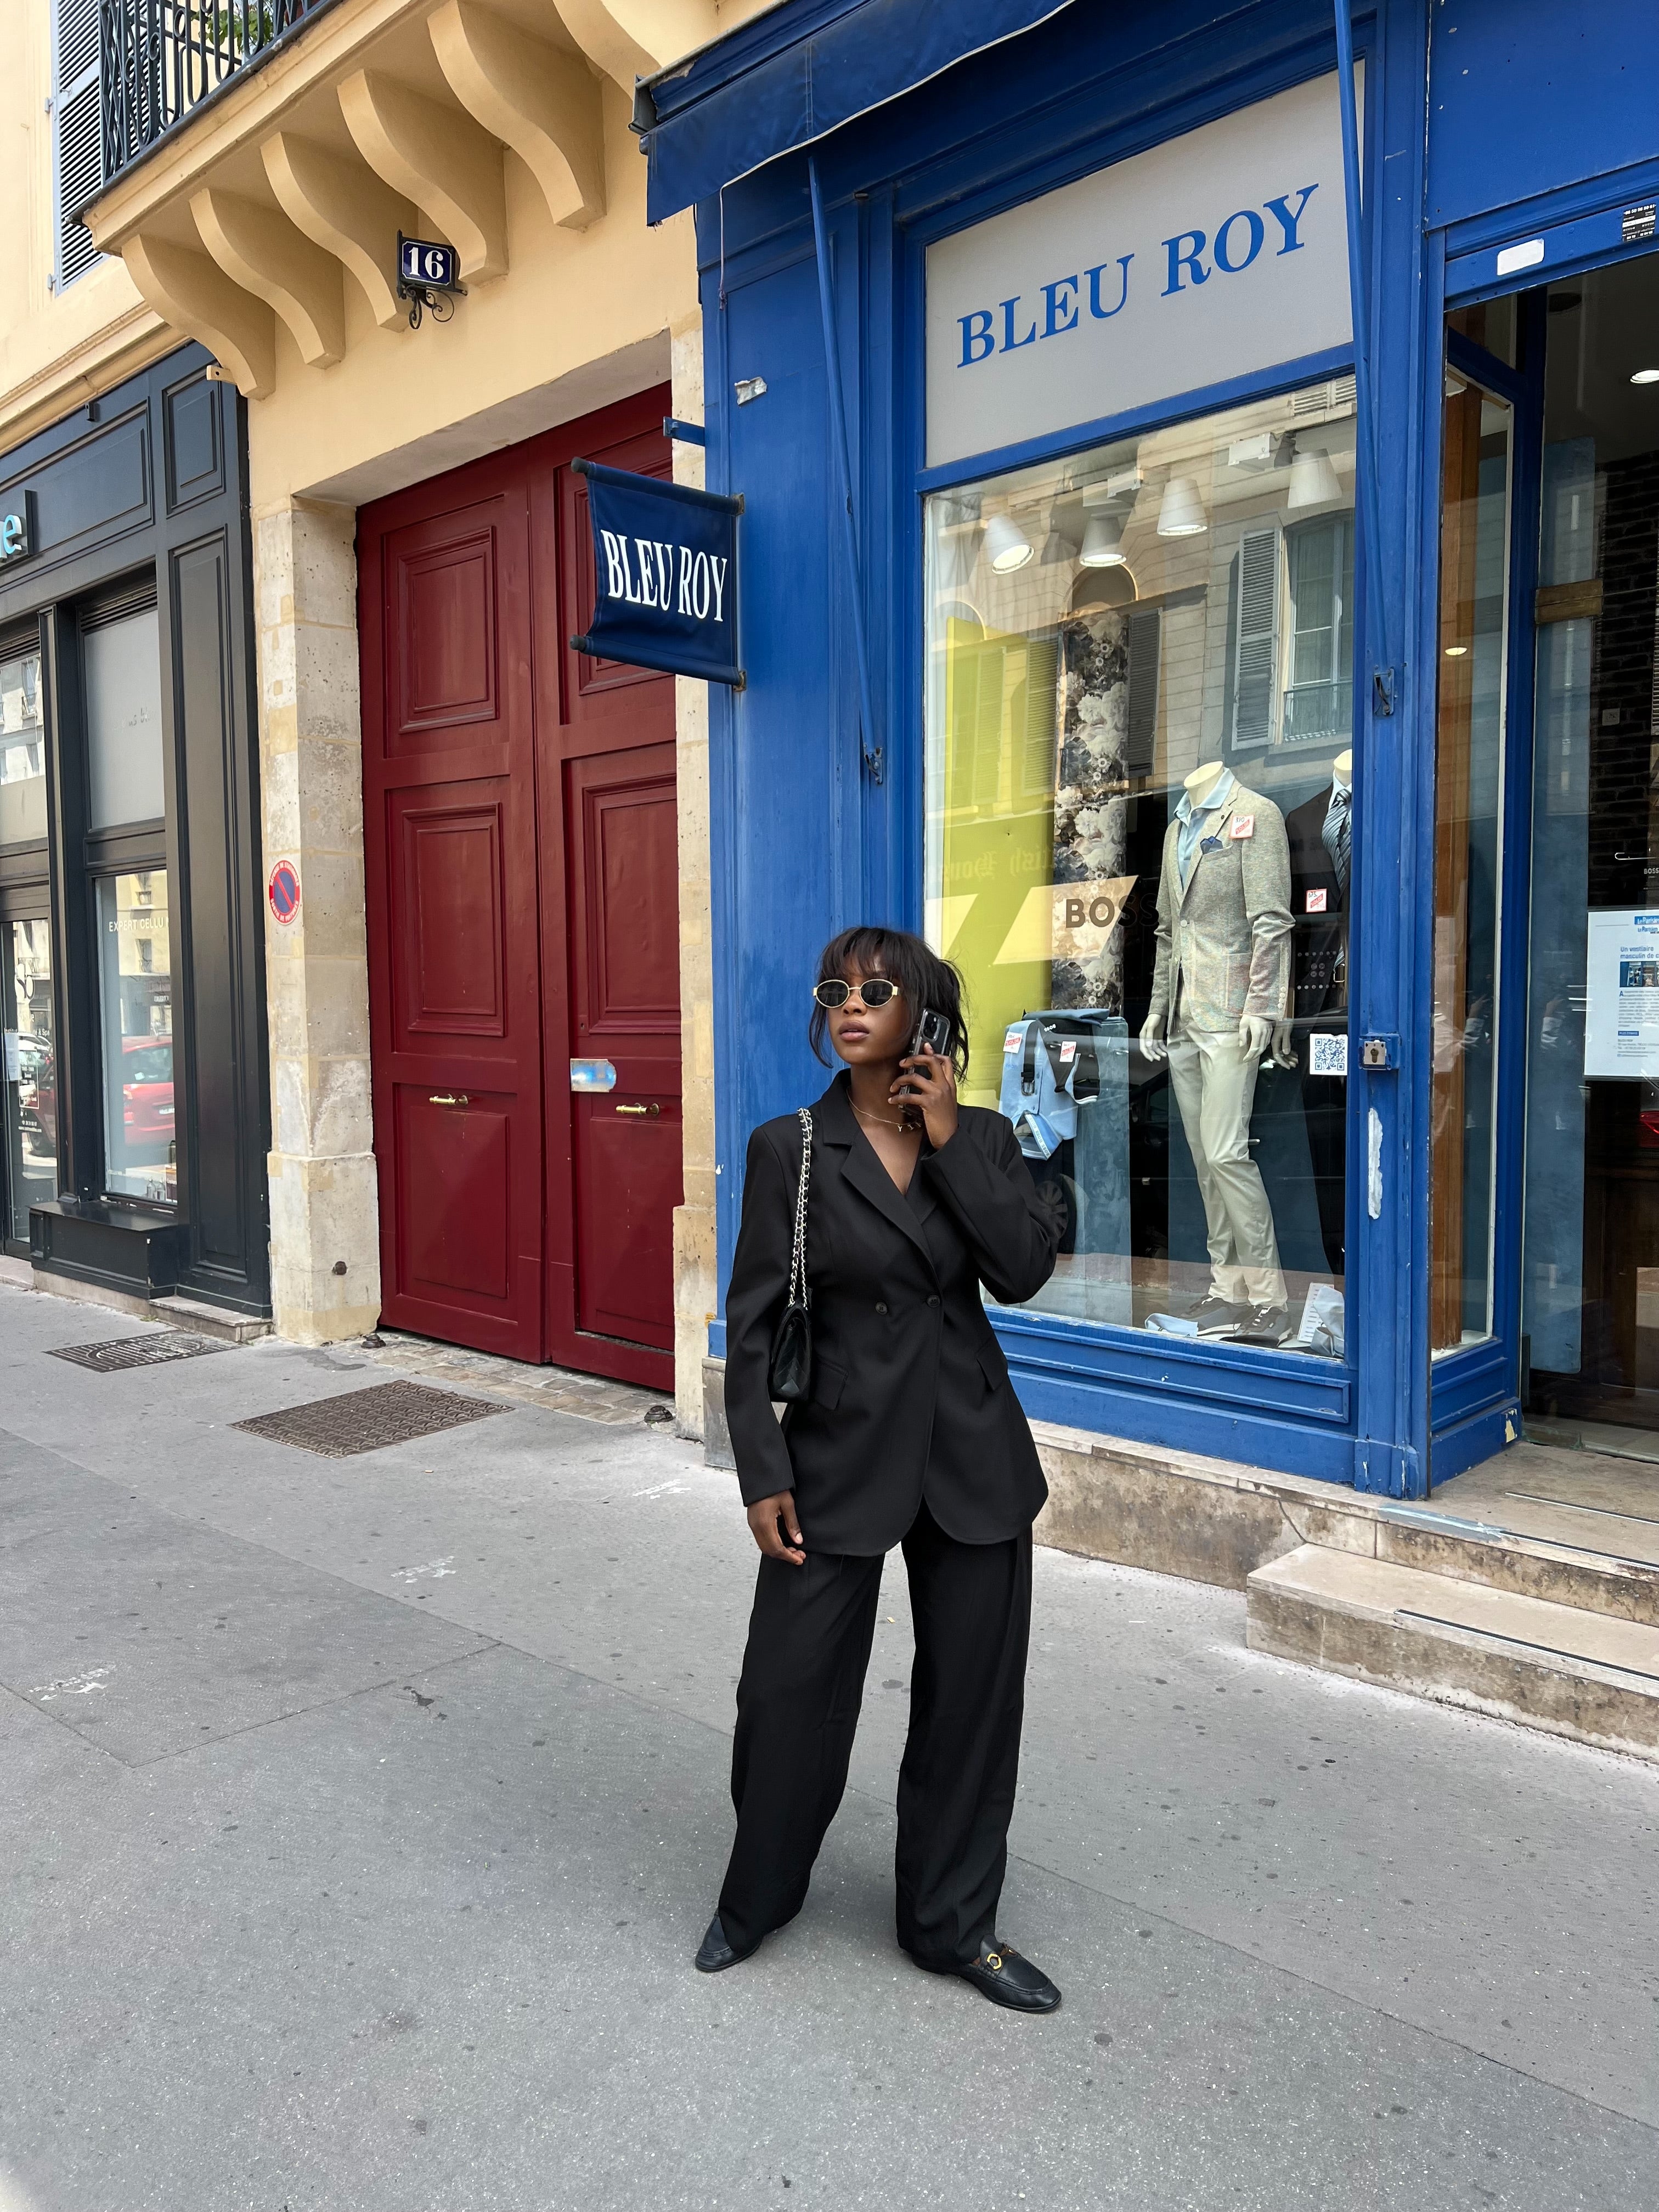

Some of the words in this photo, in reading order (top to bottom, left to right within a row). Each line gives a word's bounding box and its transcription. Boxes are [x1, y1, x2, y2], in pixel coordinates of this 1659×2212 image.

[409, 247, 444, 279] 16
[957, 253, 1135, 368] BLEU
[1161, 184, 1318, 296] ROY
[601, 529, 673, 611] BLEU
[678, 546, 727, 622] ROY
[109, 919, 137, 932] EXPERT
[1066, 893, 1159, 928] BOSS
